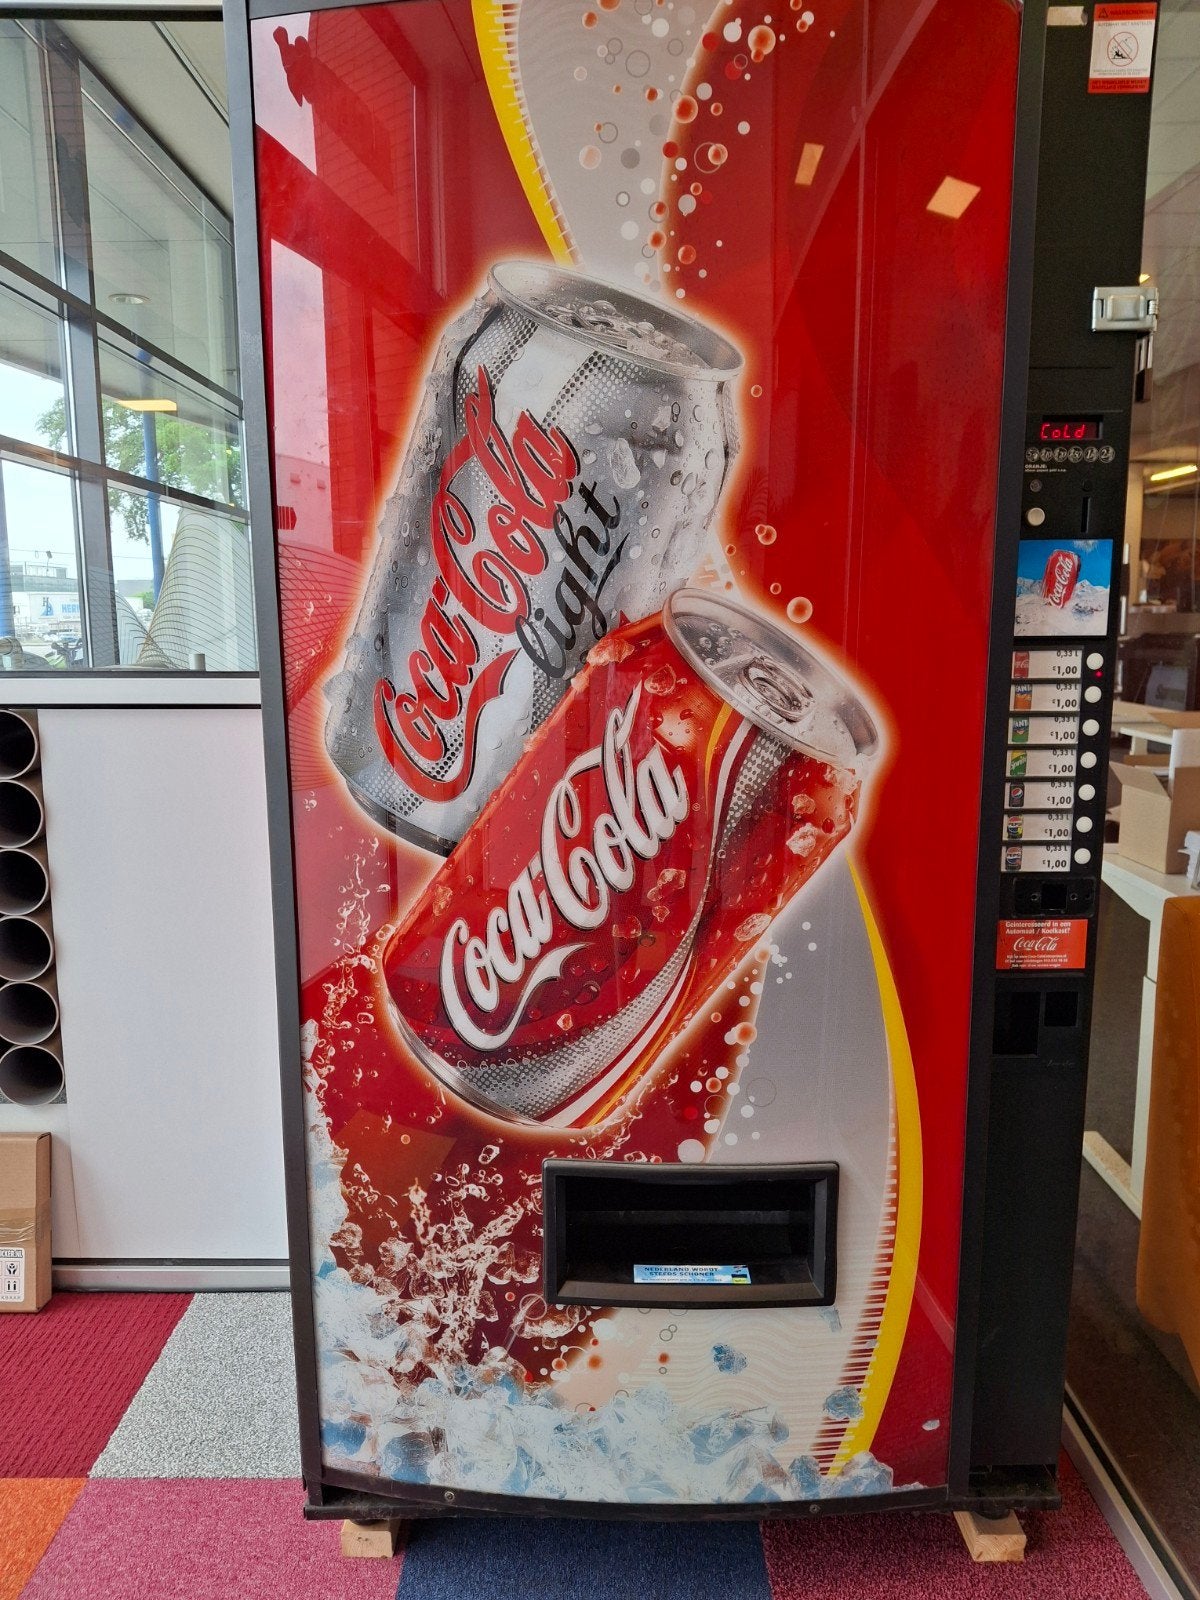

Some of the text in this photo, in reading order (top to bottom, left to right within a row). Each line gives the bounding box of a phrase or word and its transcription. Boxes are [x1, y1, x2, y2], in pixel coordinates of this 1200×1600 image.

[374, 364, 580, 804] Coca-Cola
[1049, 554, 1073, 608] Coca-Cola
[439, 679, 690, 1051] Coca-Cola
